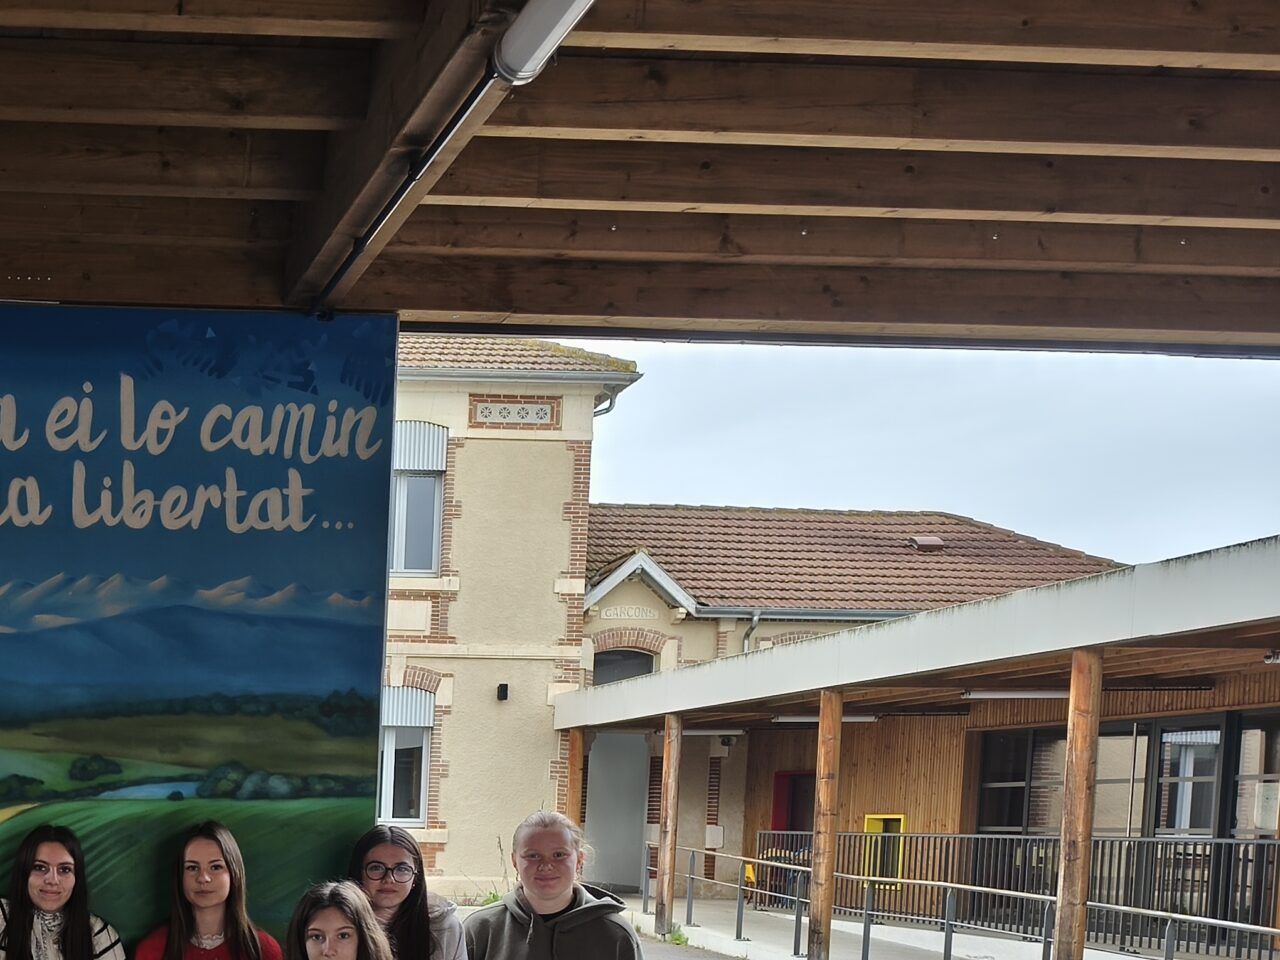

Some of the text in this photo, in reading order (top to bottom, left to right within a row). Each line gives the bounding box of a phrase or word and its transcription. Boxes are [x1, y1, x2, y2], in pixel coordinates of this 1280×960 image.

[45, 381, 108, 453] ei
[120, 371, 190, 456] lo
[199, 399, 383, 465] camin
